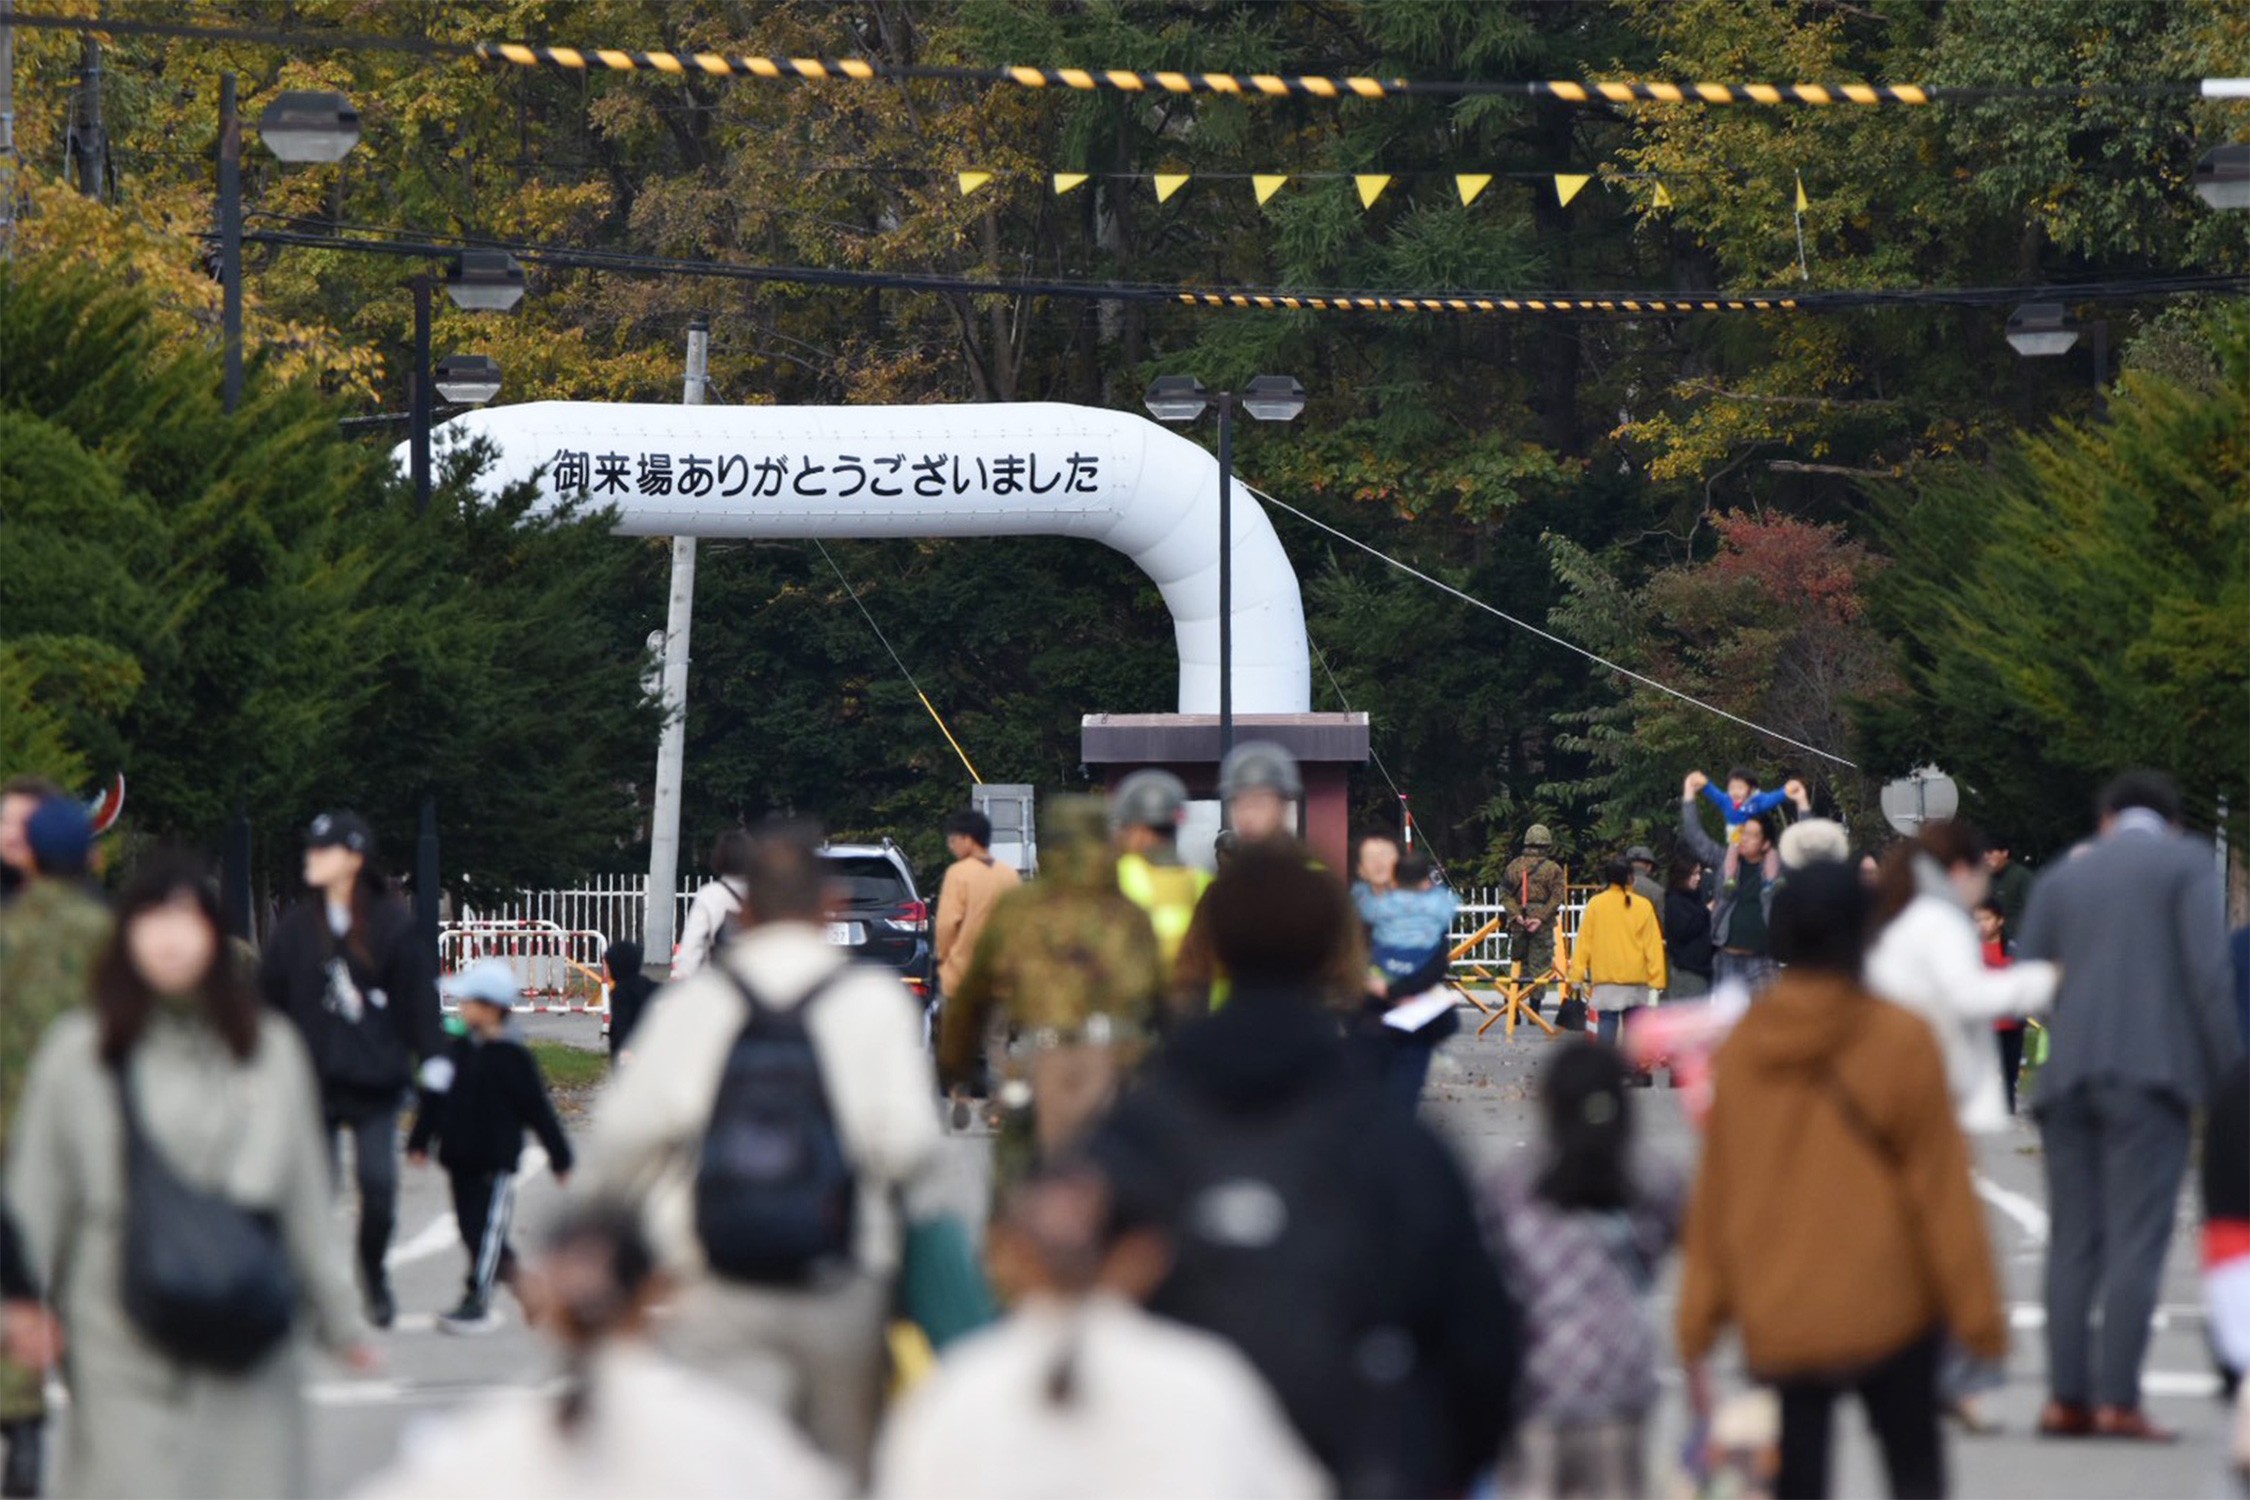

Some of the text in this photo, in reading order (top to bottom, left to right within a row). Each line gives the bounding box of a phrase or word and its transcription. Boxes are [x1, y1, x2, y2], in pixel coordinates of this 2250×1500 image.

[552, 448, 1099, 497] 御来場ありがとうございました
